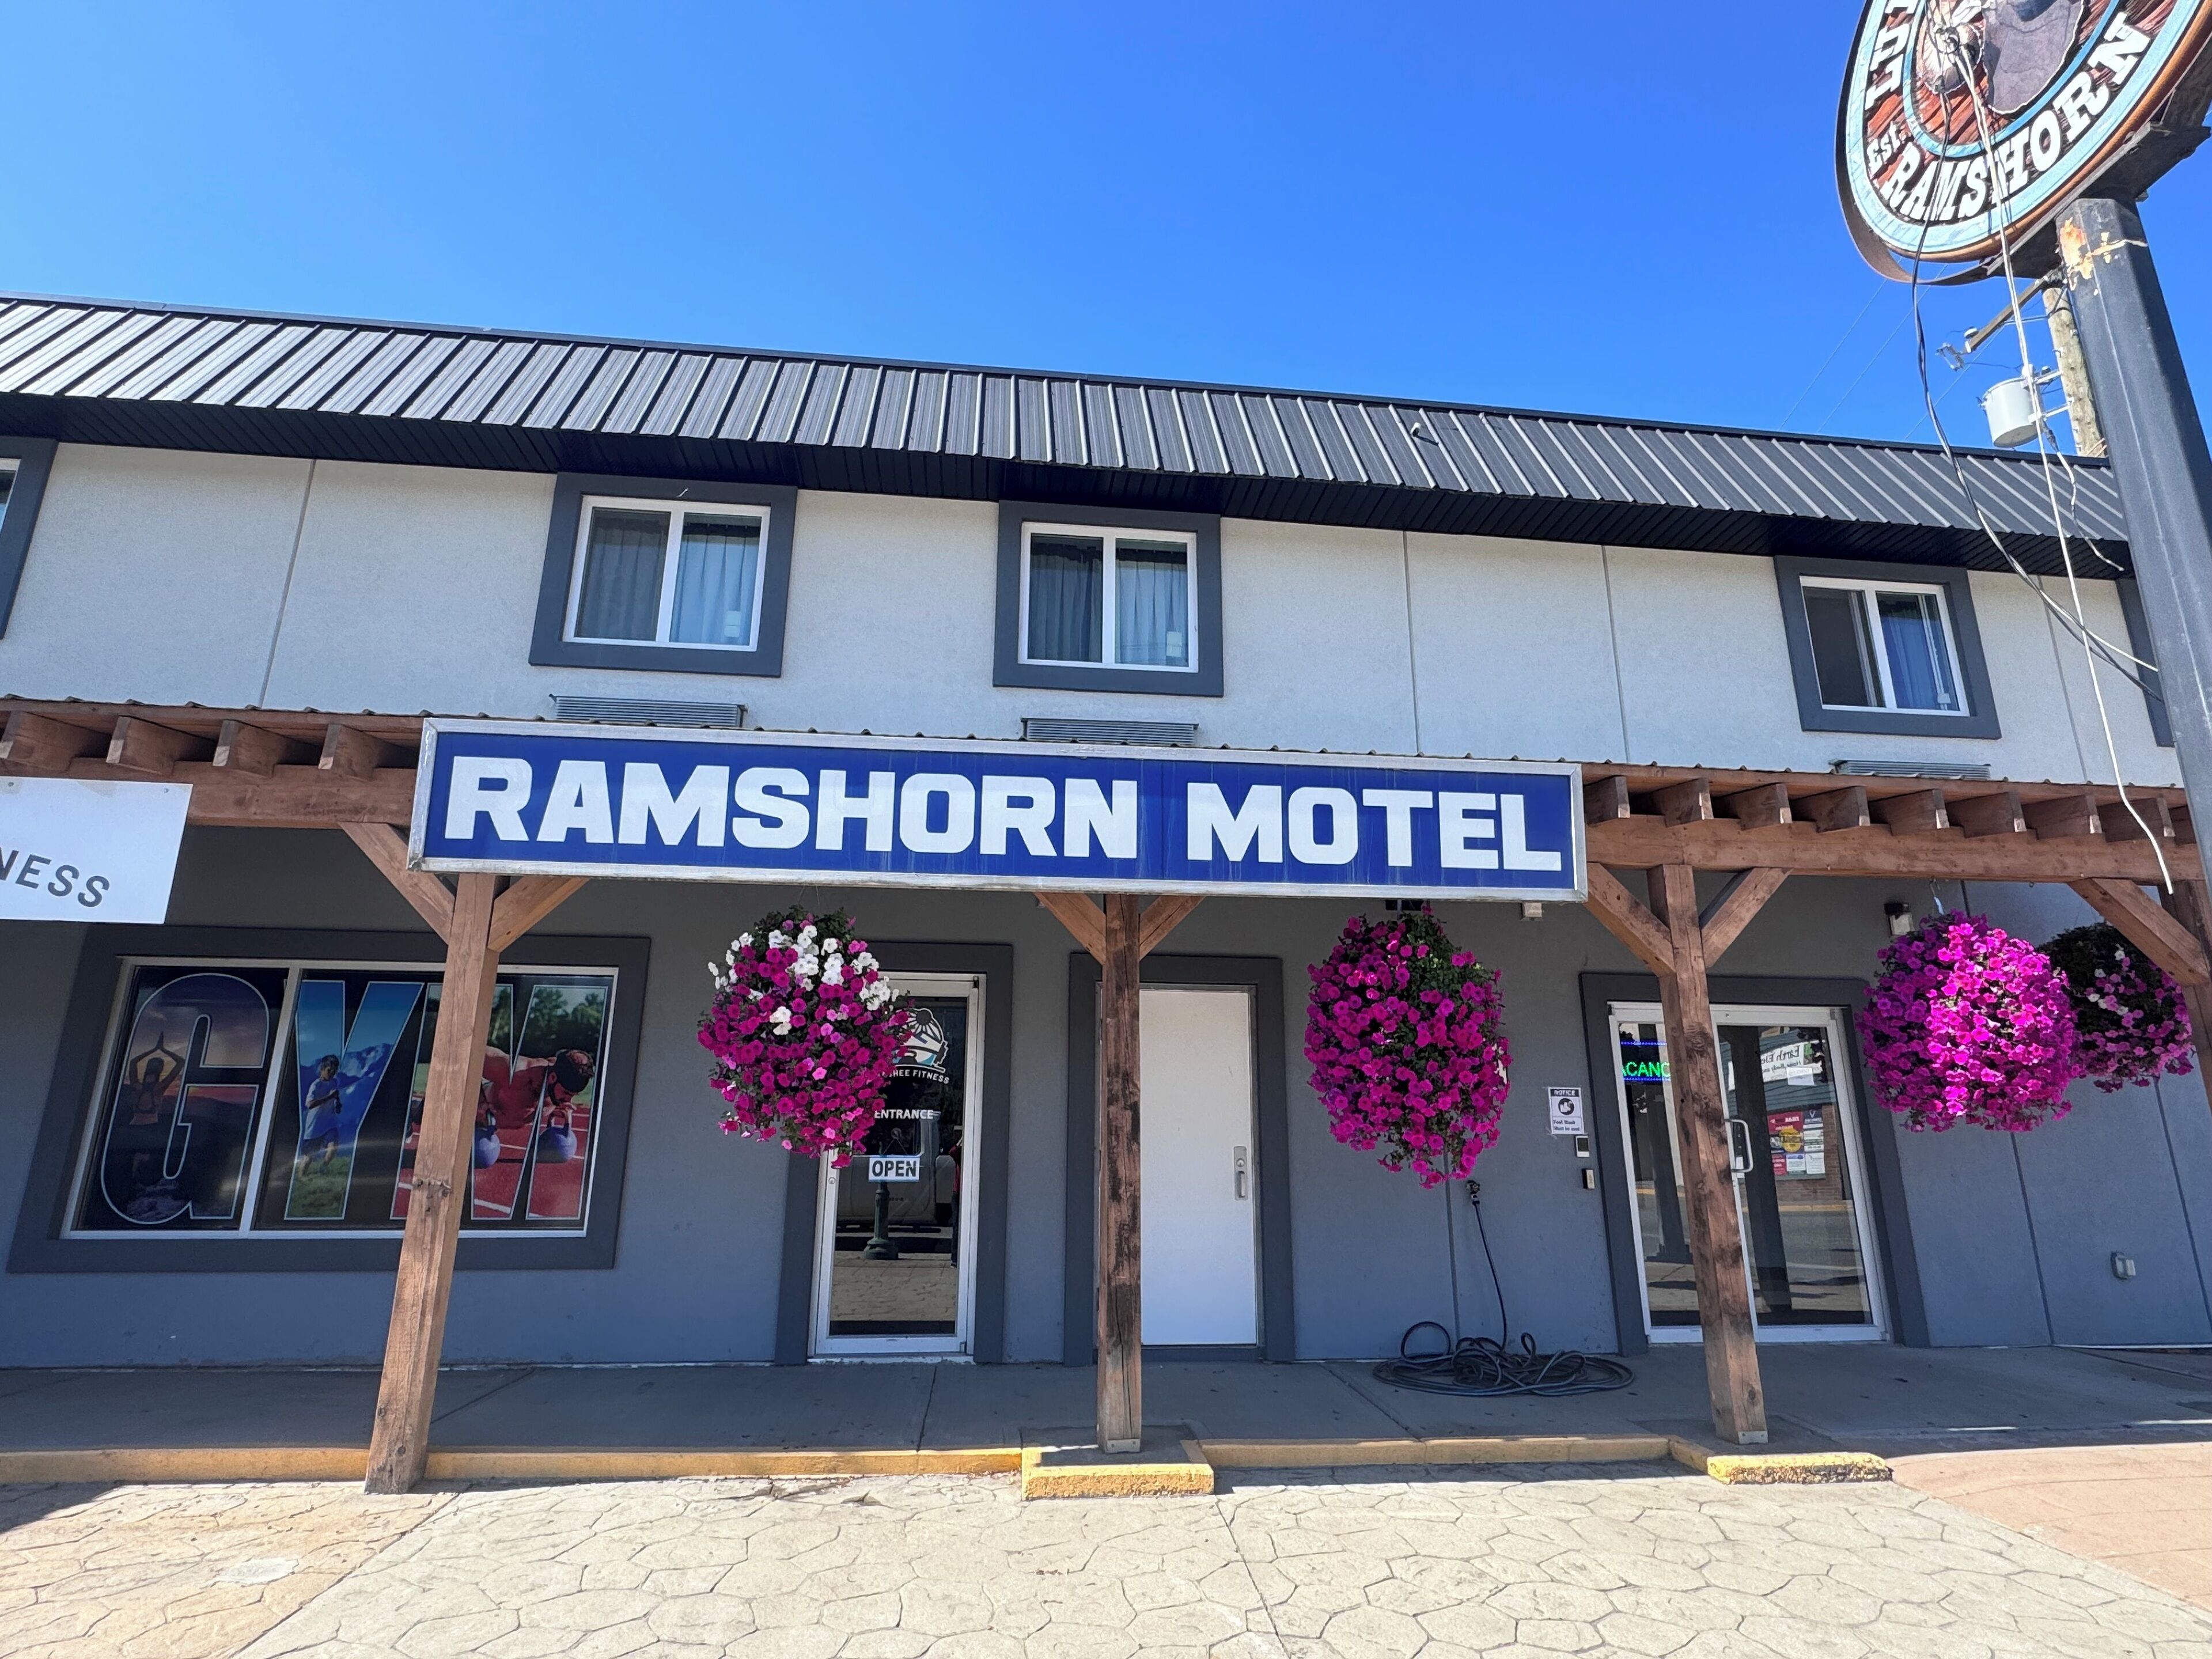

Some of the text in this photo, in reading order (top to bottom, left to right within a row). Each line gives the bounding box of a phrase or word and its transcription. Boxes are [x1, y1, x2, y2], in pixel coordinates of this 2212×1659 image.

[1878, 12, 2150, 221] RAMSHORN
[444, 756, 1562, 871] RAMSHORN MOTEL
[101, 972, 608, 1225] GYM
[912, 1070, 950, 1084] FITNESS
[874, 1108, 934, 1119] ENTRANCE
[871, 1160, 917, 1177] OPEN
